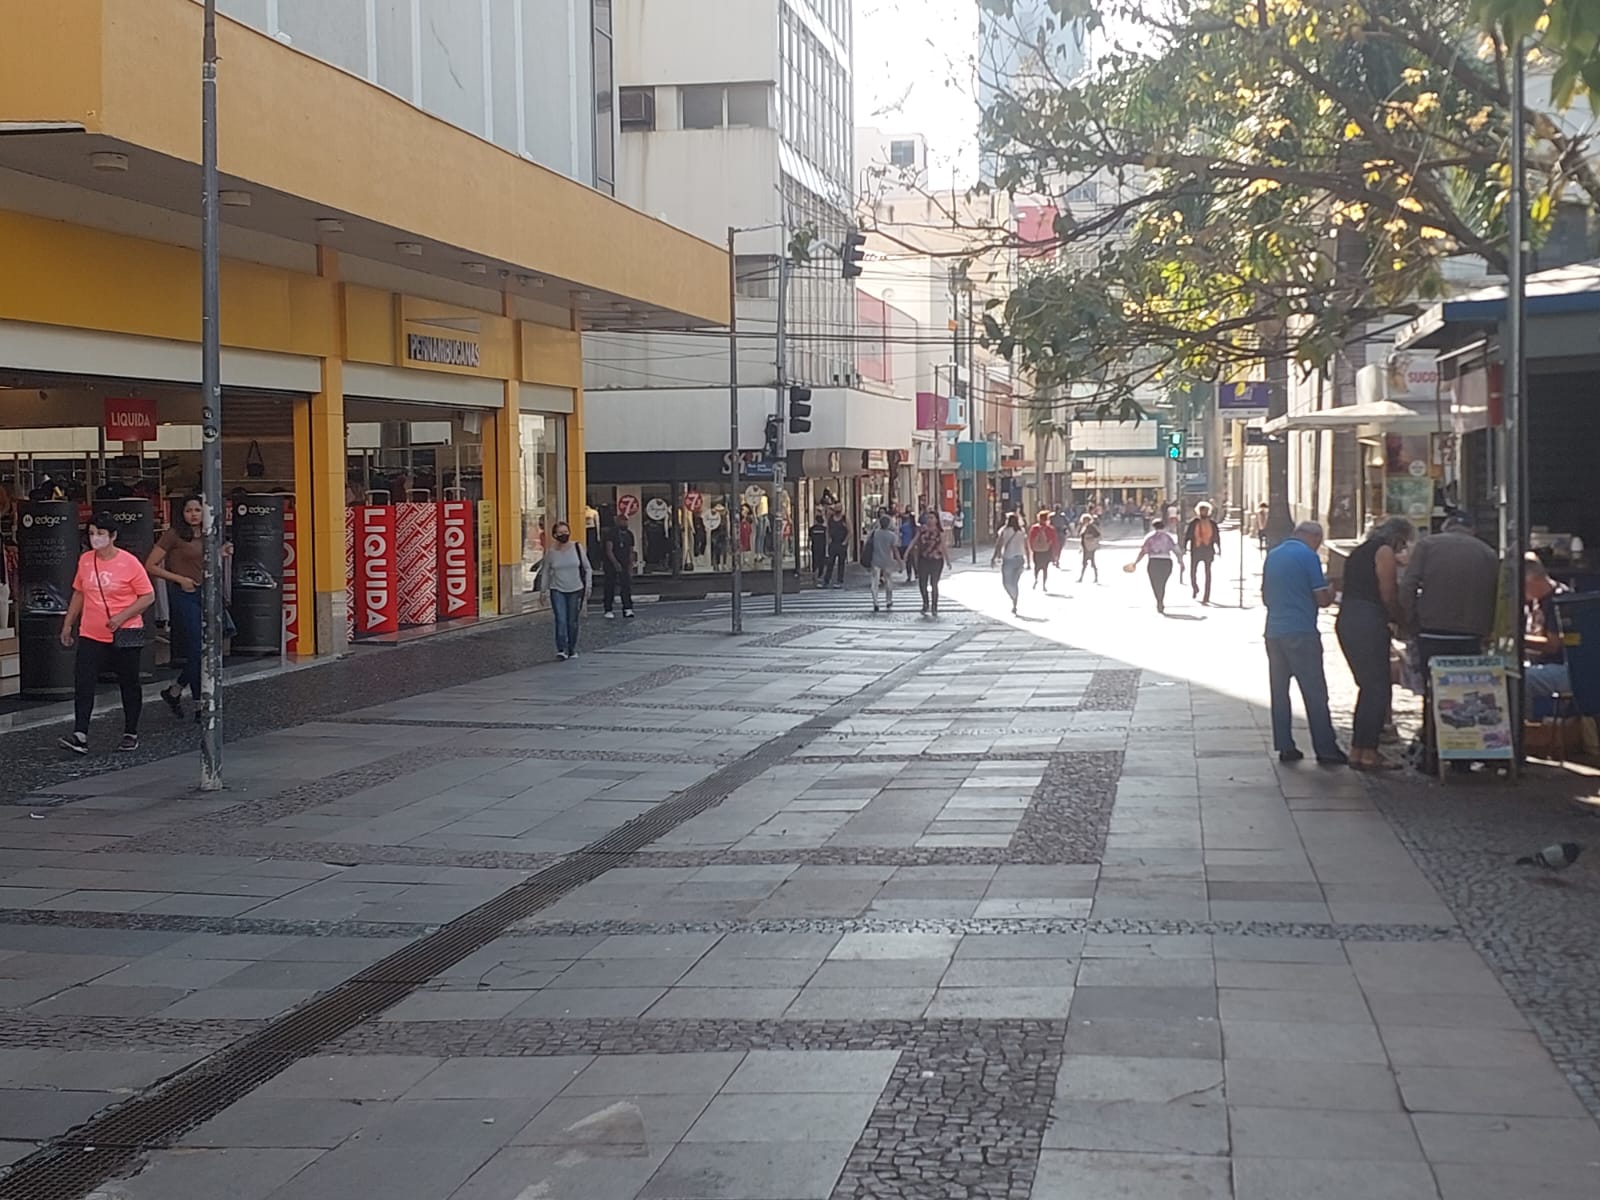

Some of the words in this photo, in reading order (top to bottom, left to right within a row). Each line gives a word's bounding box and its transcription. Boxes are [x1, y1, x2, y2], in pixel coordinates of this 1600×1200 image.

[408, 334, 480, 368] PERNAMBUCANAS
[111, 412, 151, 428] LIQUIDA
[34, 514, 61, 528] edge
[248, 505, 271, 517] edge
[364, 508, 388, 630] LIQUIDA
[443, 503, 467, 613] LIQUIDA
